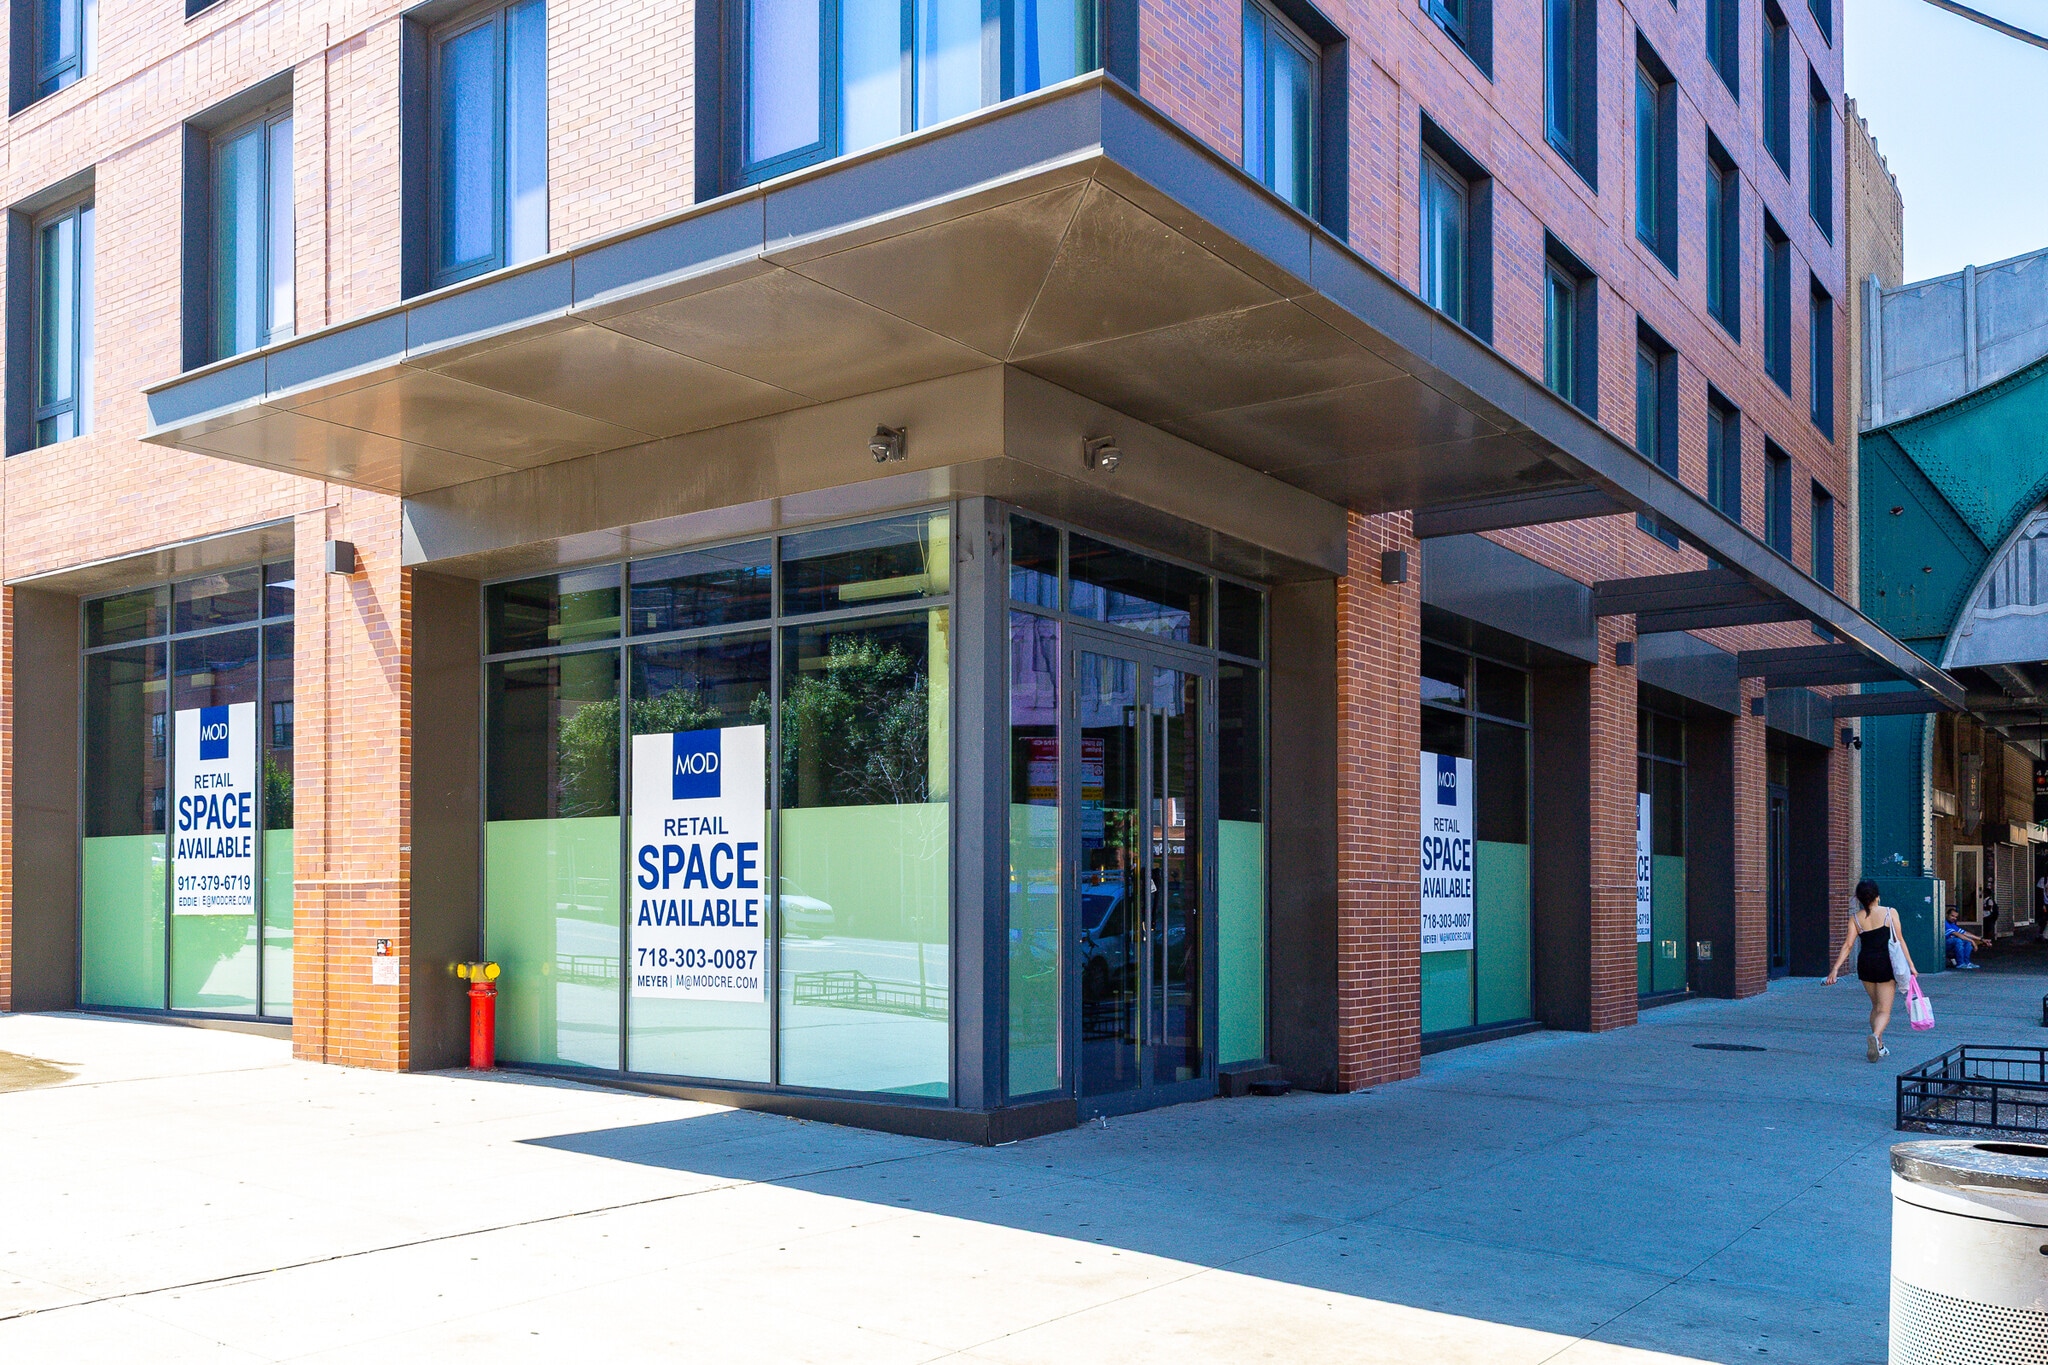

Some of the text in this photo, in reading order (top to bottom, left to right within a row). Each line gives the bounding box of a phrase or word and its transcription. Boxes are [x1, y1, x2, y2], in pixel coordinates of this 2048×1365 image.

[201, 723, 228, 741] MOD
[675, 752, 719, 775] MOD
[194, 773, 233, 789] RETAIL
[1438, 771, 1456, 788] MOD
[178, 792, 251, 831] SPACE
[664, 816, 729, 837] RETAIL
[1433, 817, 1460, 833] RETAIL
[178, 836, 251, 859] AVAILABLE
[1422, 836, 1471, 871] SPACE
[637, 842, 758, 890] SPACE
[177, 875, 251, 890] 917-379-6719
[1422, 877, 1471, 899] AVAILABLE
[179, 895, 252, 907] EDDIE E@MODCRE.COM
[637, 899, 759, 928] AVAILABLE
[1422, 913, 1471, 929] 718-303-0087
[1423, 934, 1437, 944] MEYER
[637, 948, 758, 970] 718-303-0087
[637, 974, 759, 990] MEYER M@MODCRE.COM
